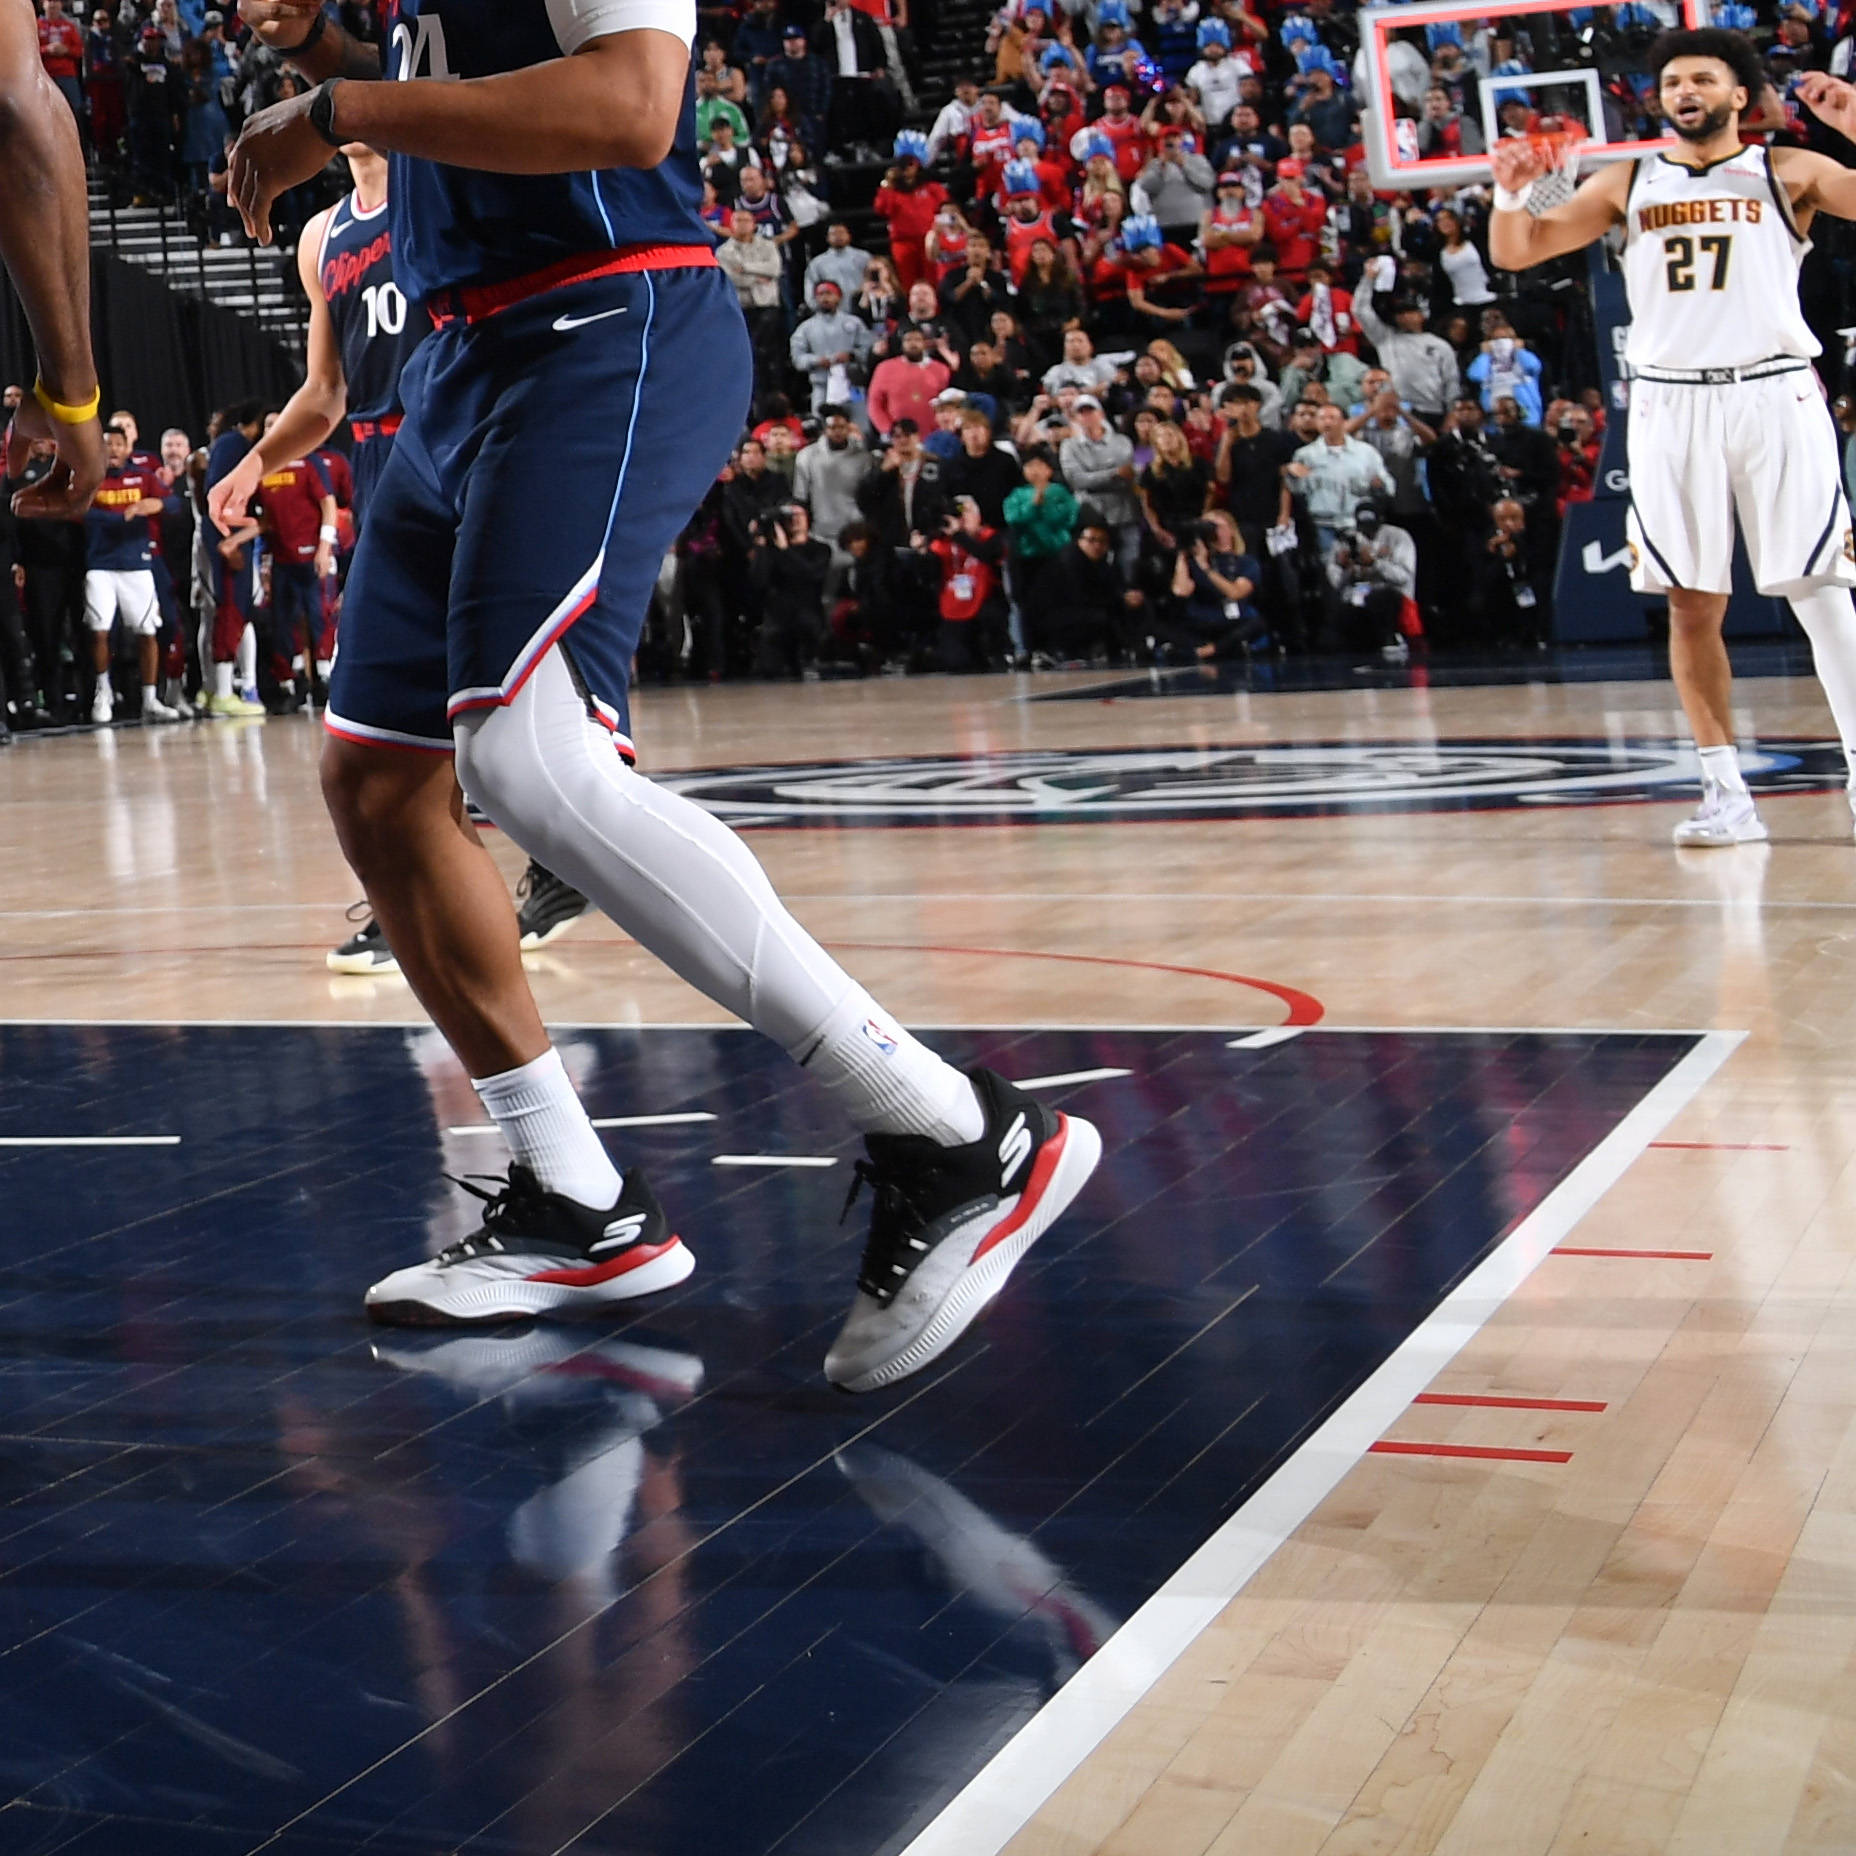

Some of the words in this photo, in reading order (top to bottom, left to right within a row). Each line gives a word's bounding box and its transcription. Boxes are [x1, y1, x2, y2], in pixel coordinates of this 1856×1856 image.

[1639, 198, 1762, 232] NUGGETS
[322, 230, 393, 302] Clipper
[1665, 235, 1735, 292] 27
[361, 282, 407, 337] 10
